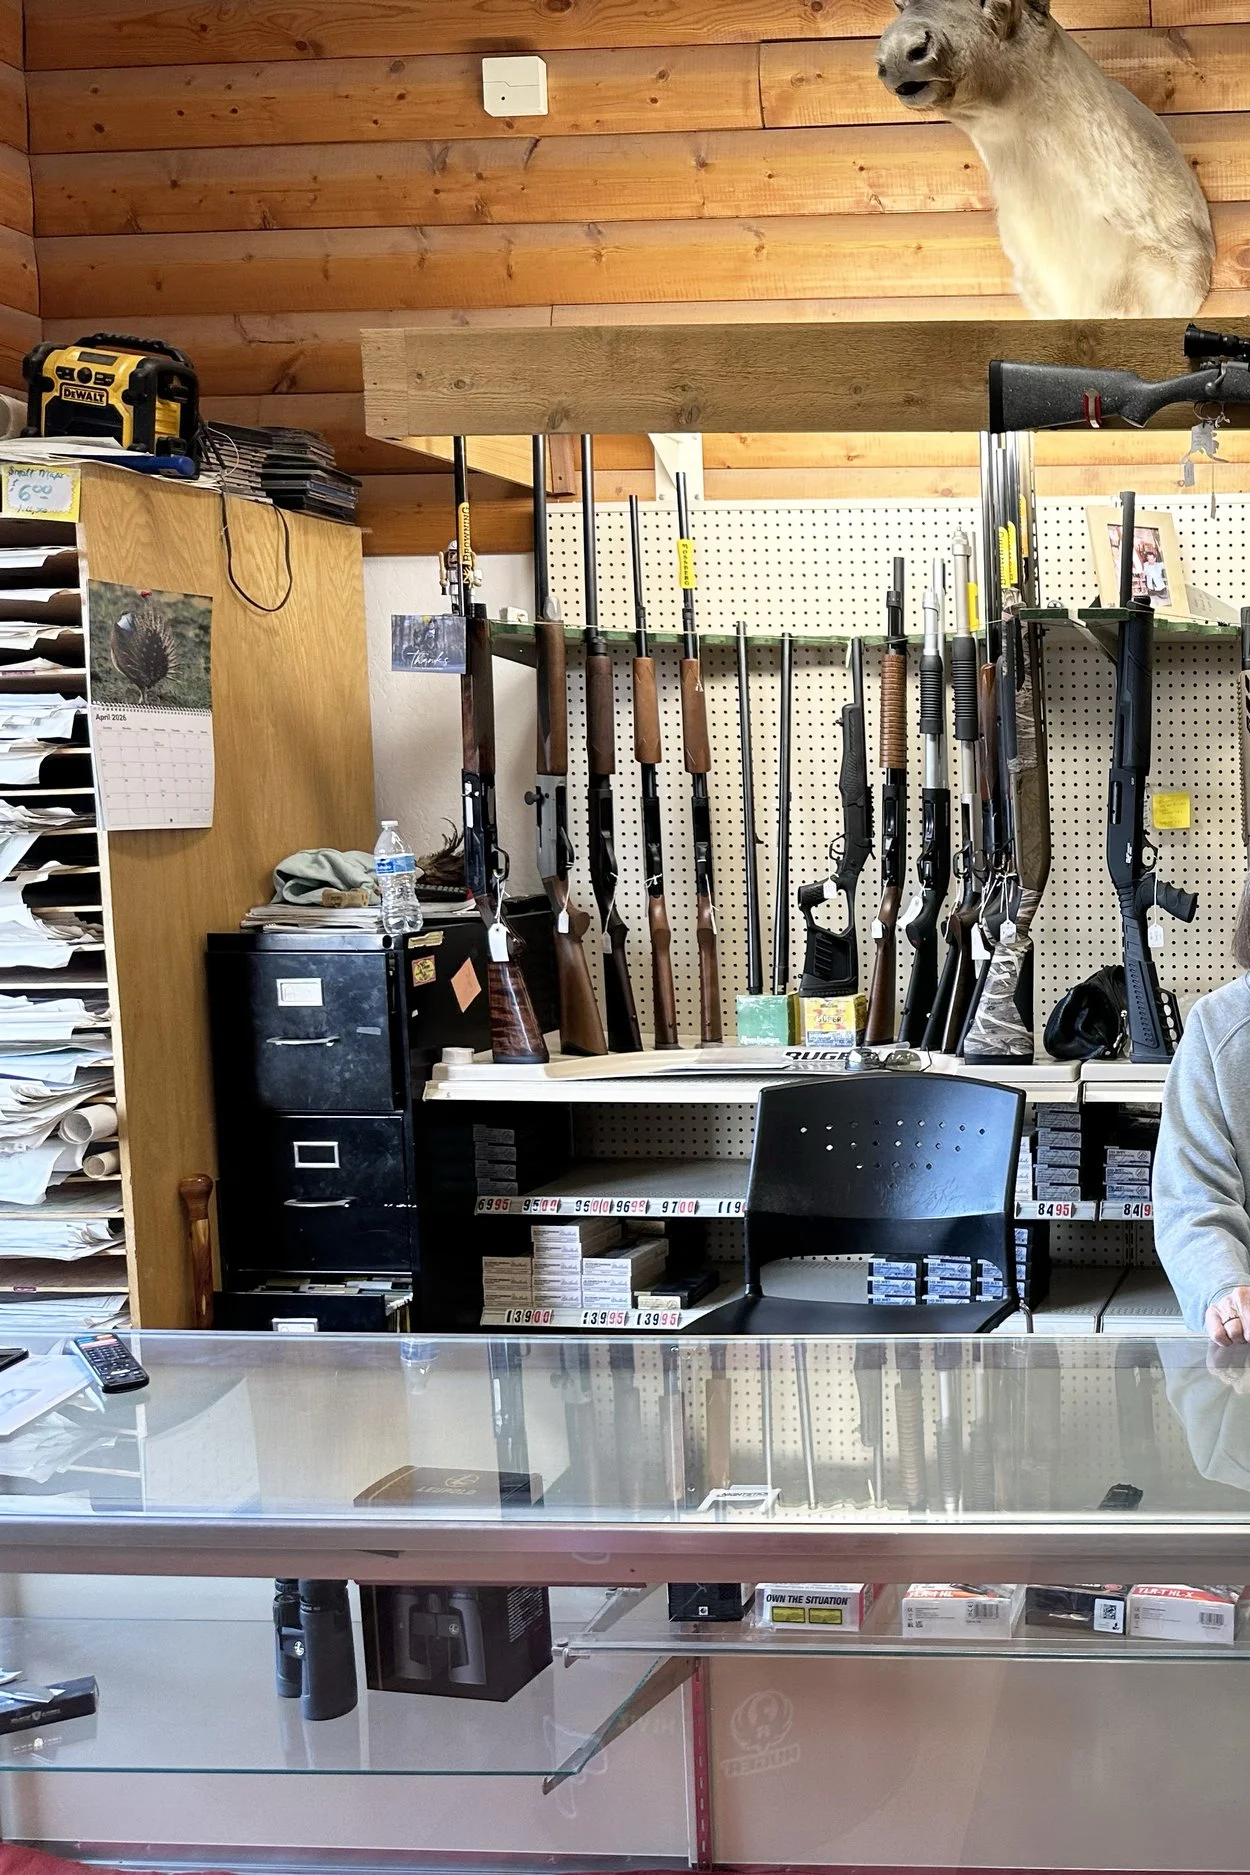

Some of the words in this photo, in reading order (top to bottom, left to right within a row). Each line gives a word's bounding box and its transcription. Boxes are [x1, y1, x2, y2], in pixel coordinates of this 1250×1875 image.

[96, 714, 110, 722] April
[1124, 1204, 1152, 1216] 849
[766, 1594, 786, 1603] OWN
[788, 1595, 803, 1604] THE
[806, 1596, 848, 1605] SITUATION
